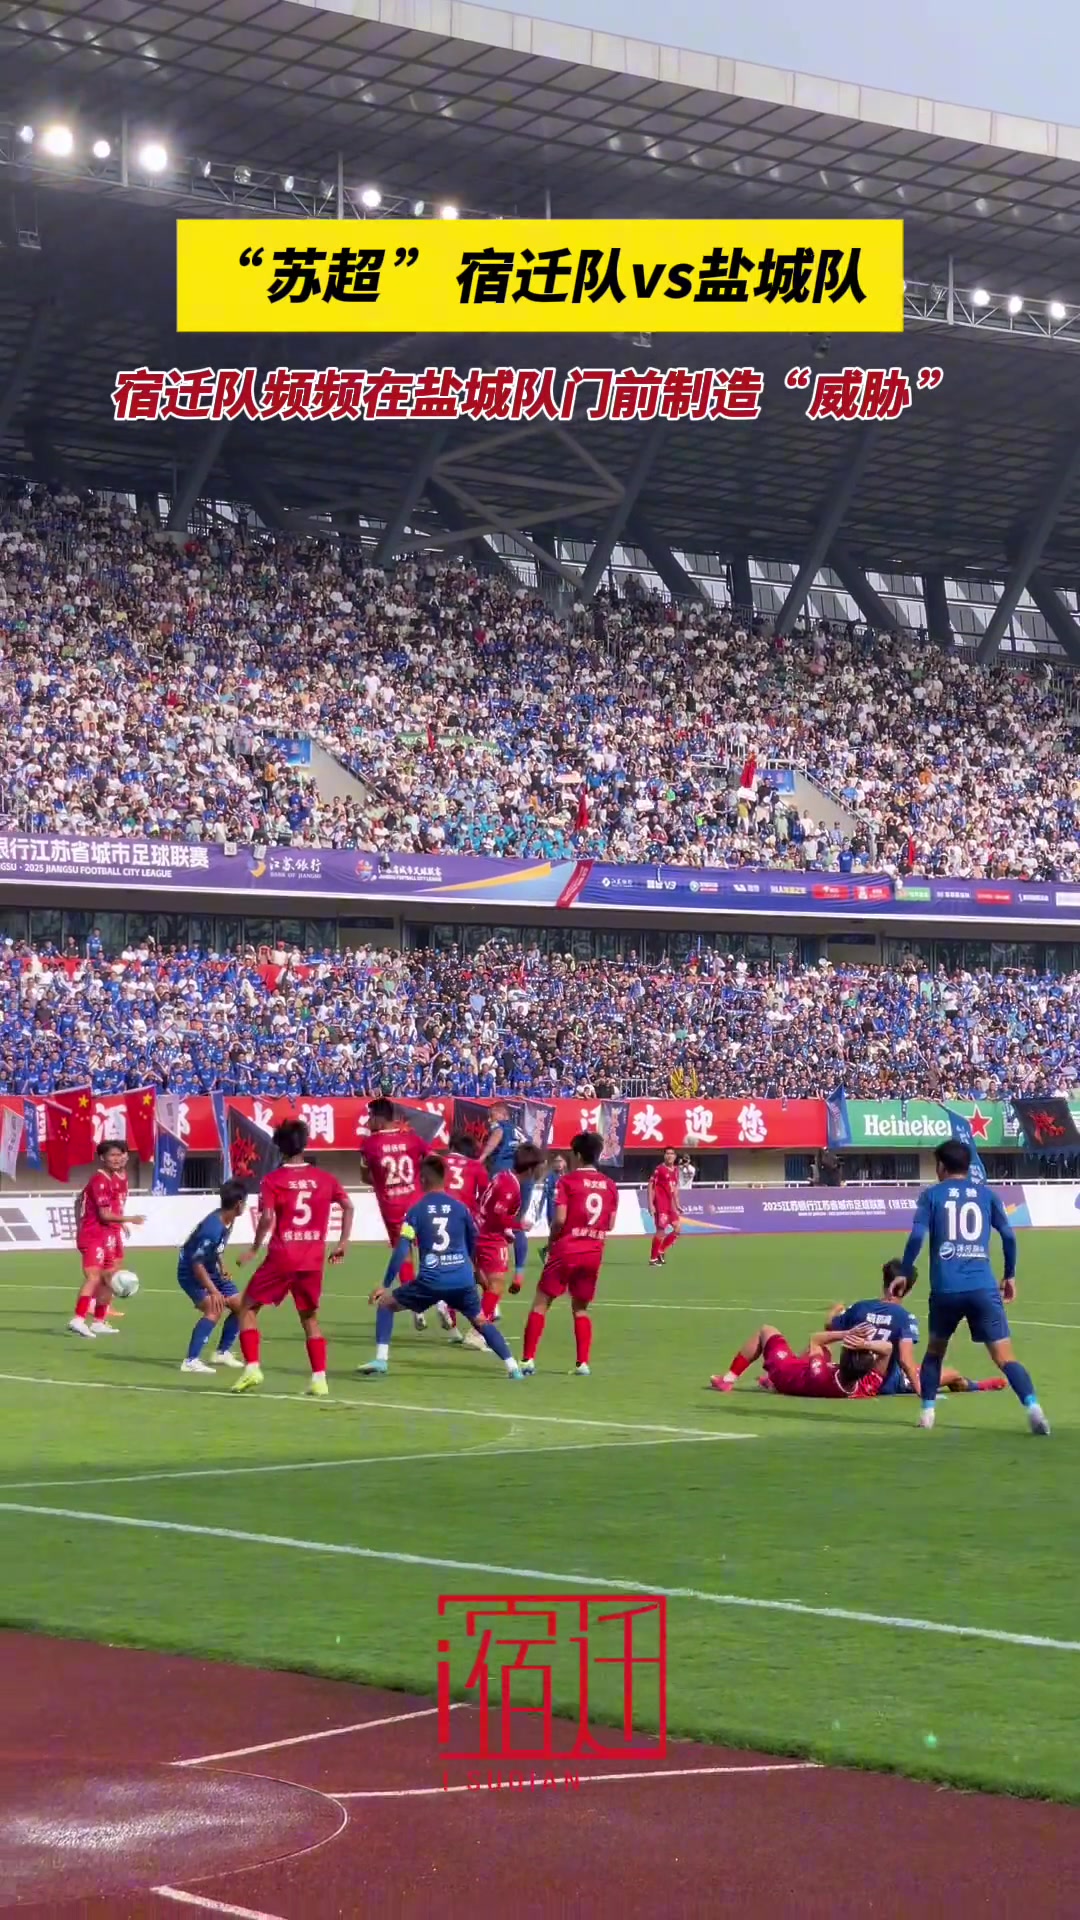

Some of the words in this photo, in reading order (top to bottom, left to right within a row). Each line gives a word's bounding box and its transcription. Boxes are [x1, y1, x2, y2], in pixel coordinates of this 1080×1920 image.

[24, 864, 44, 873] 2025
[45, 865, 79, 875] JIANGSU
[80, 866, 121, 876] FOOTBALL
[122, 868, 140, 876] CITY
[141, 869, 173, 878] LEAGUE
[269, 856, 322, 872] 江苏银行
[380, 1155, 414, 1185] 20
[449, 1166, 465, 1190] 3
[292, 1190, 313, 1226] 5
[585, 1192, 603, 1226] 9
[944, 1201, 983, 1241] 10
[432, 1217, 450, 1251] 3
